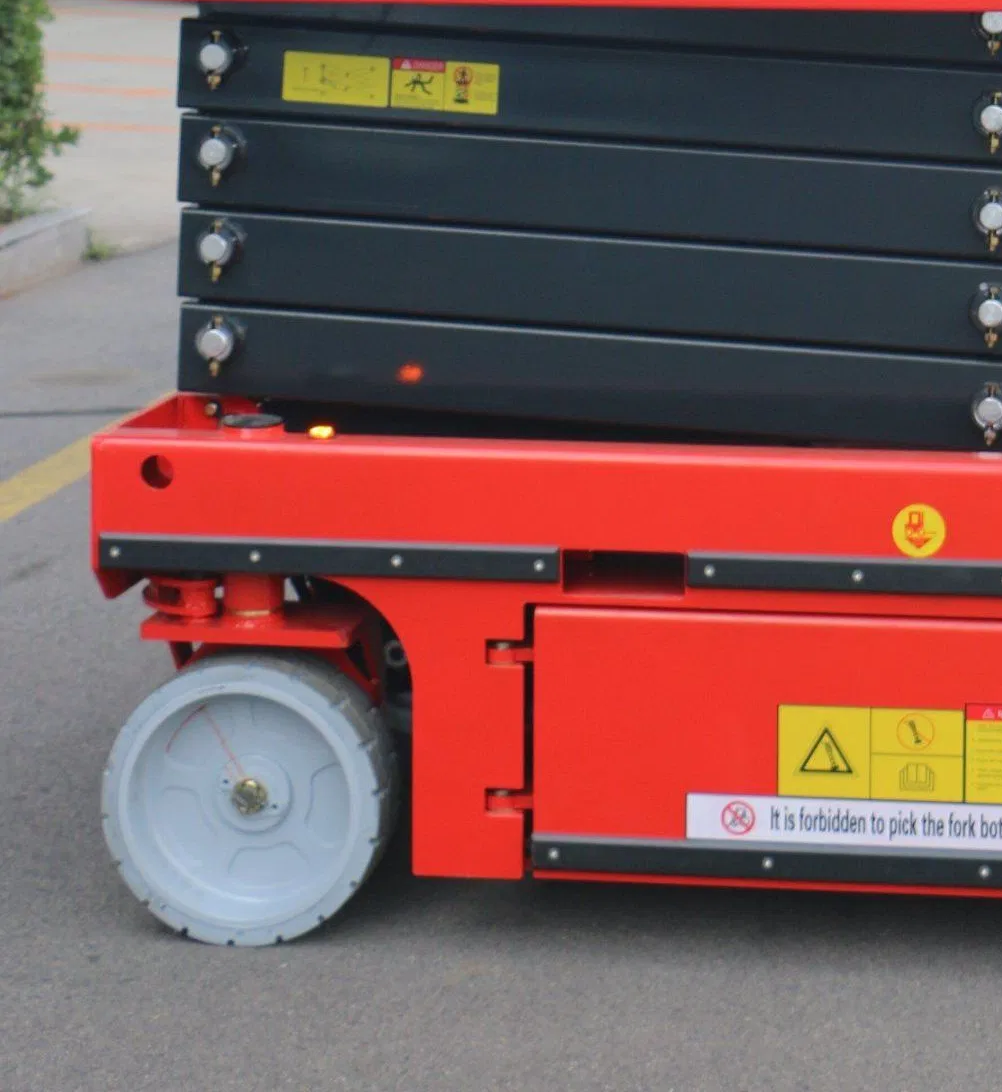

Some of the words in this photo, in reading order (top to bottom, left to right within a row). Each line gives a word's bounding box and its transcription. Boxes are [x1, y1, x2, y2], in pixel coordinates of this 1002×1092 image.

[771, 806, 780, 830] It
[784, 806, 795, 830] is
[800, 807, 866, 834] forbidden
[871, 815, 885, 835] to
[889, 810, 917, 840] pick
[921, 812, 944, 837] the
[949, 812, 976, 838] fork
